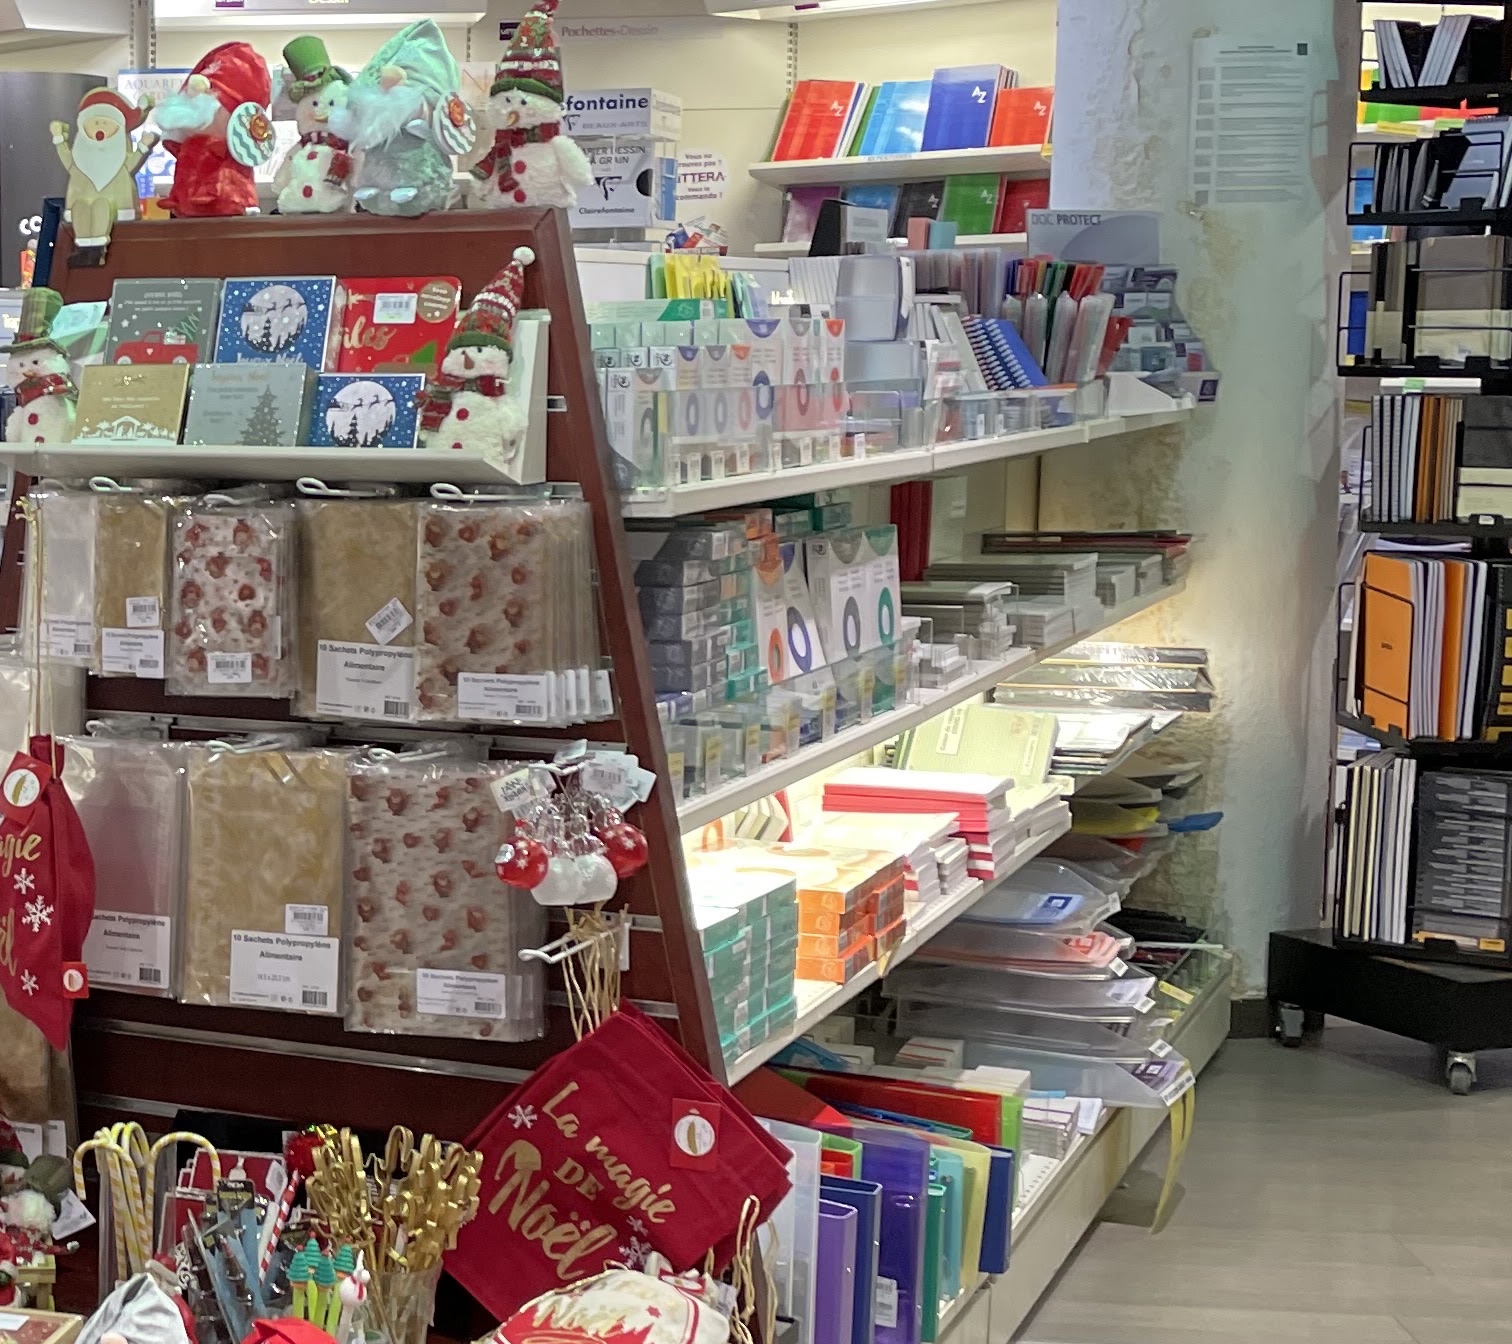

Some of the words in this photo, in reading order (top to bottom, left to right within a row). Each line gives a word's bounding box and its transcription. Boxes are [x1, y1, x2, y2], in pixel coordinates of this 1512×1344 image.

[561, 93, 649, 112] fontaine
[1031, 214, 1054, 225] DOC
[1056, 213, 1102, 226] PROTECT
[329, 644, 357, 655] Sachets
[344, 660, 386, 672] Alimentaire
[94, 914, 116, 923] achets
[103, 928, 141, 940] Alimentaire
[233, 933, 242, 942] 10
[243, 934, 274, 946] Sachets
[275, 936, 331, 950] Polypropylène
[259, 950, 304, 962] Alimentaire
[542, 1080, 579, 1138] La
[552, 1156, 605, 1201] DE
[585, 1135, 676, 1224] magie
[487, 1166, 618, 1281] Noël
